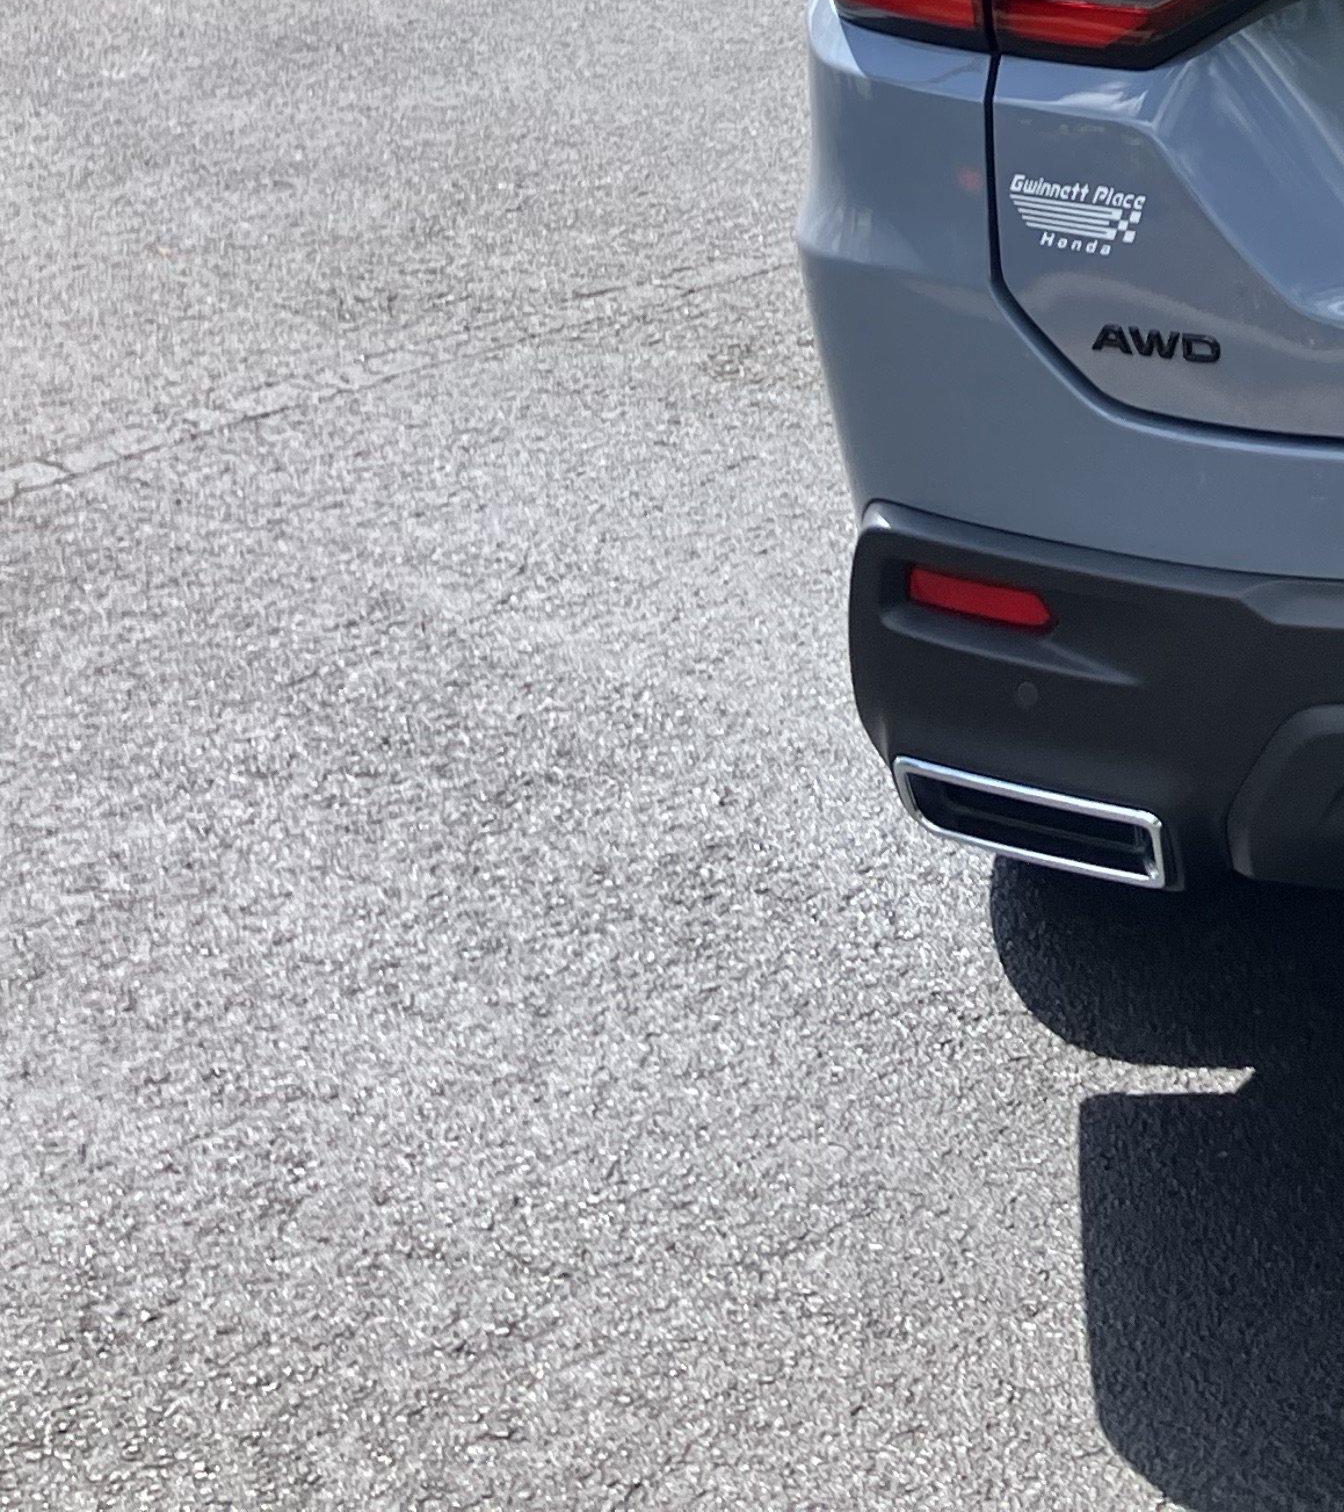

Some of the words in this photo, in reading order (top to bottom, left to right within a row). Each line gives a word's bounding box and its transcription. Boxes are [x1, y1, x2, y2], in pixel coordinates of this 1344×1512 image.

[1009, 173, 1090, 203] Gwinnett
[1092, 186, 1146, 210] Place
[1039, 232, 1111, 256] Honda
[1091, 323, 1222, 364] AWD
